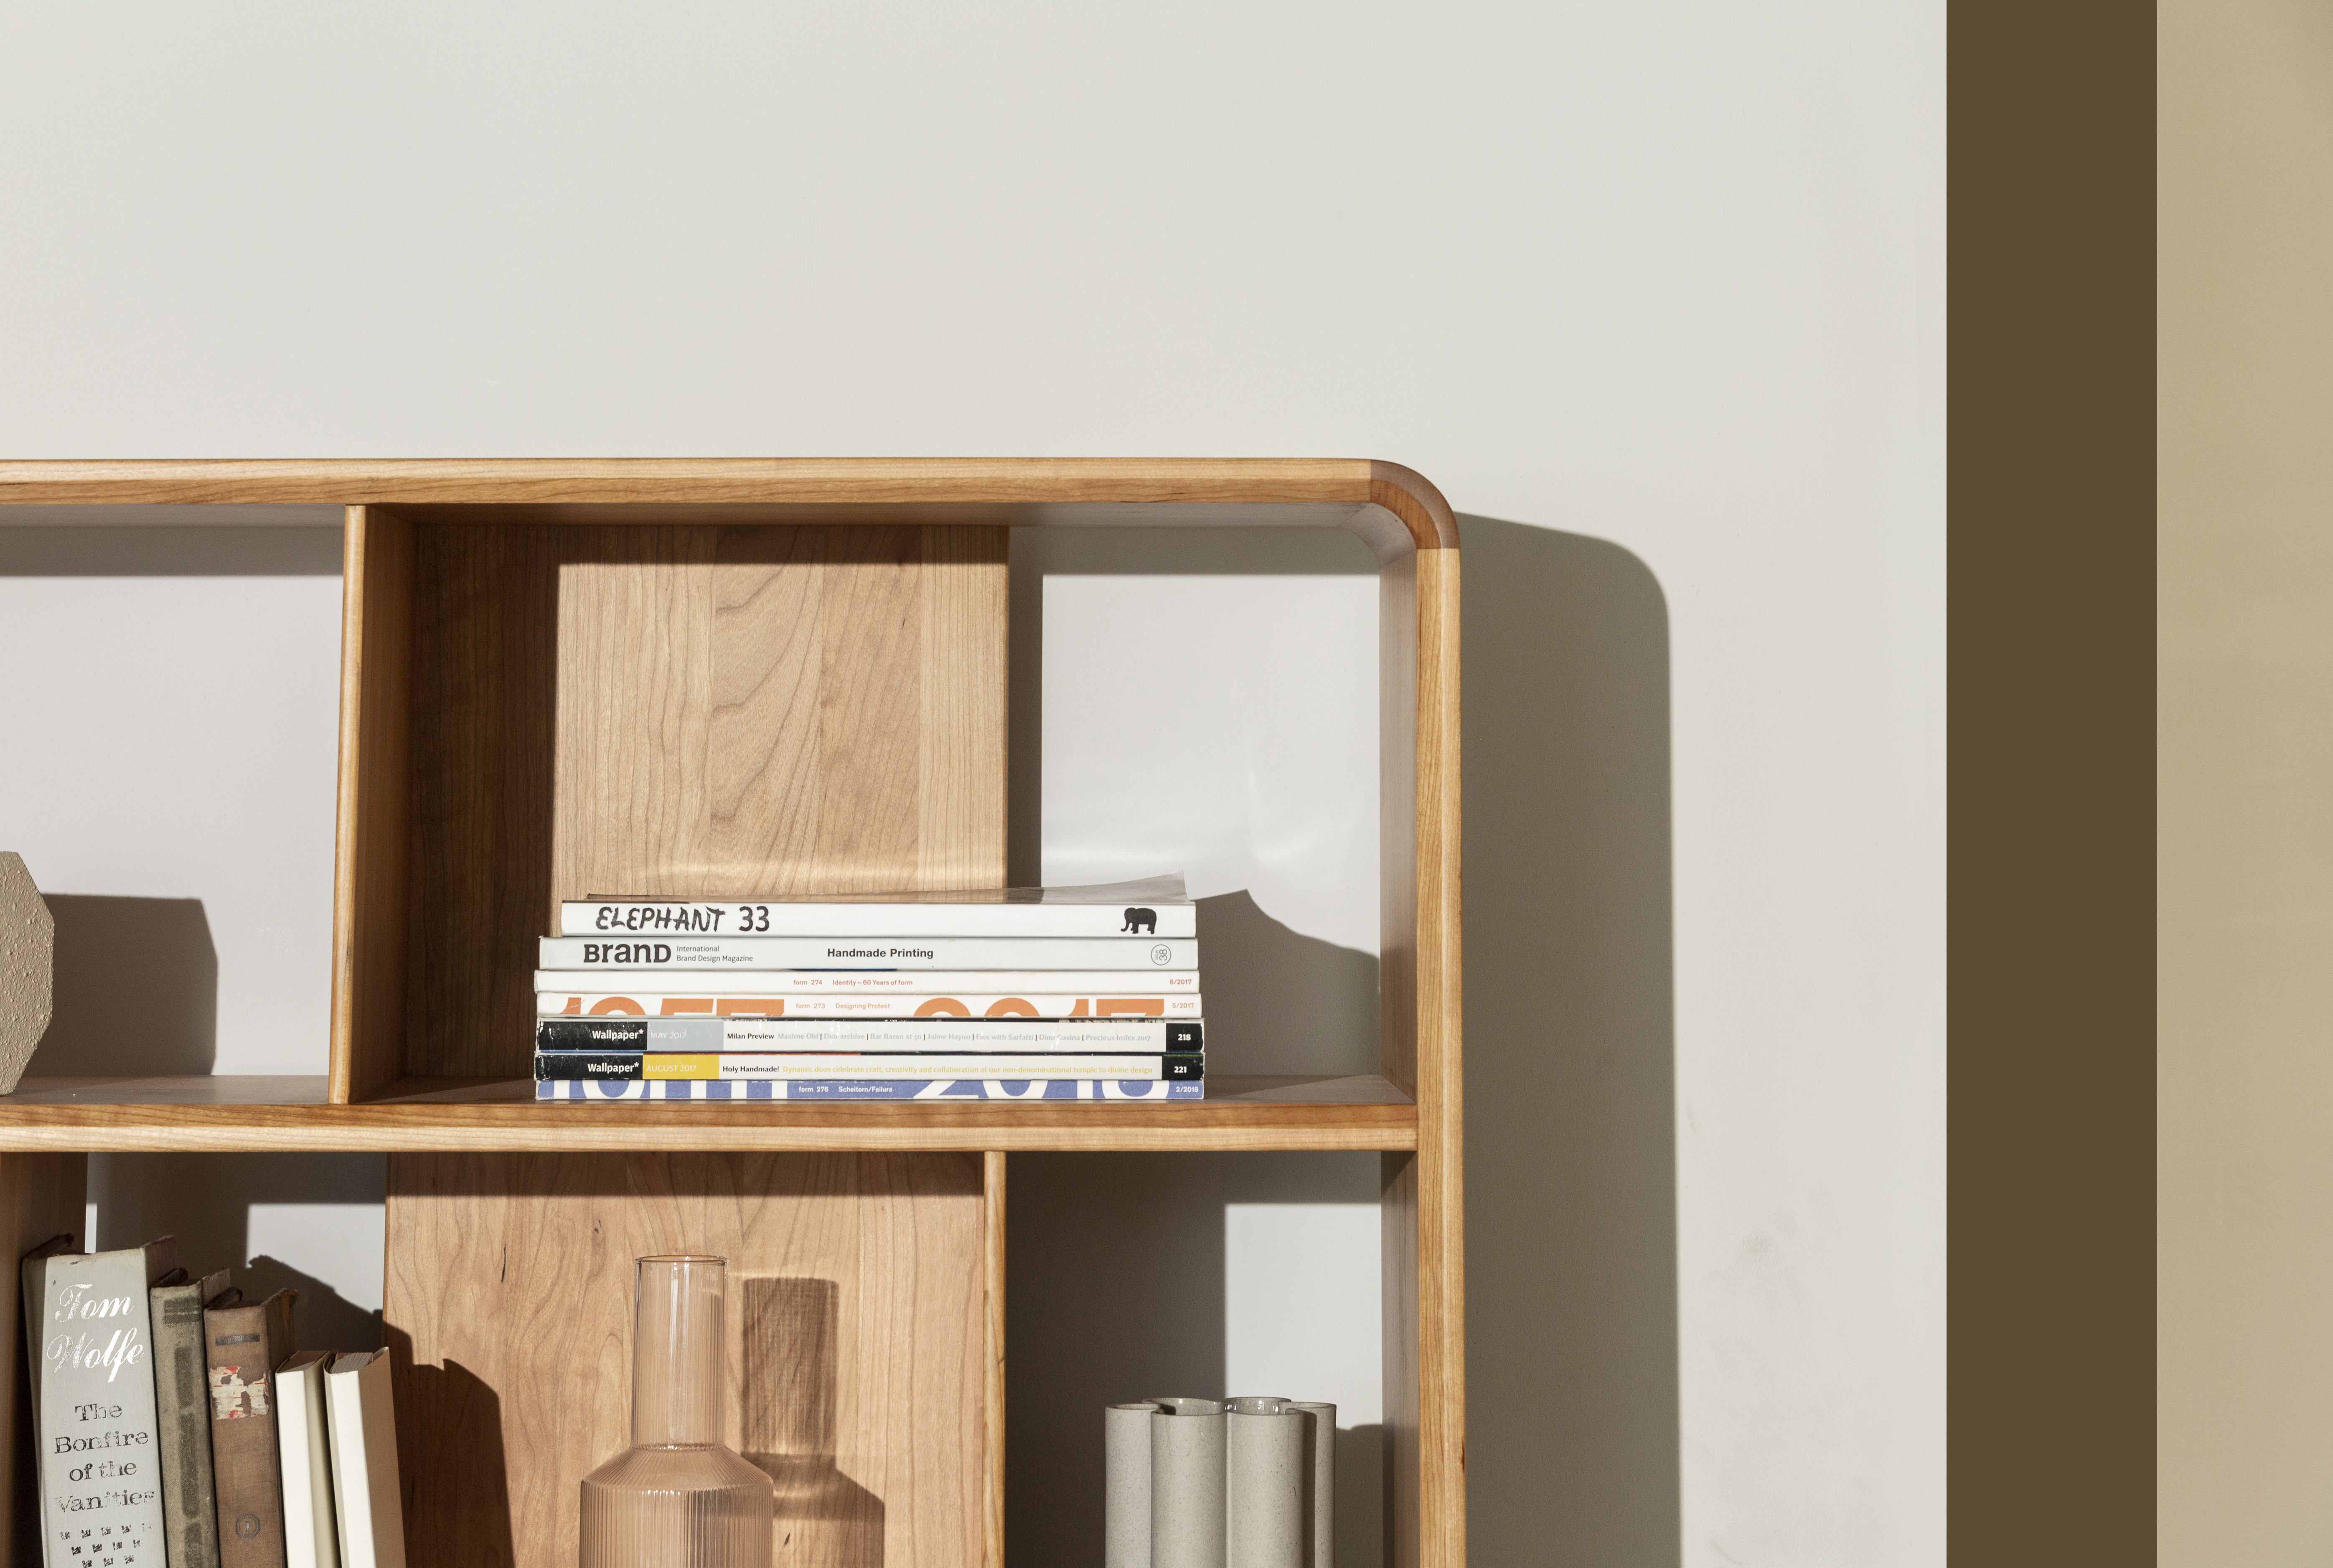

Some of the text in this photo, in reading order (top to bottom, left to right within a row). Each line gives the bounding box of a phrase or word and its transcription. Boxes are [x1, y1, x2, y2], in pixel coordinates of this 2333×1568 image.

[595, 905, 770, 932] ELEPHANT 33
[827, 948, 934, 959] Handmade Printing
[1159, 949, 1167, 961] 38
[783, 1066, 813, 1074] Dynamic
[55, 1283, 135, 1322] Tom
[46, 1327, 144, 1383] Wolfe
[75, 1403, 122, 1421] The
[54, 1431, 149, 1454] Bonfire
[69, 1461, 137, 1481] of the
[53, 1489, 155, 1512] Vanities
